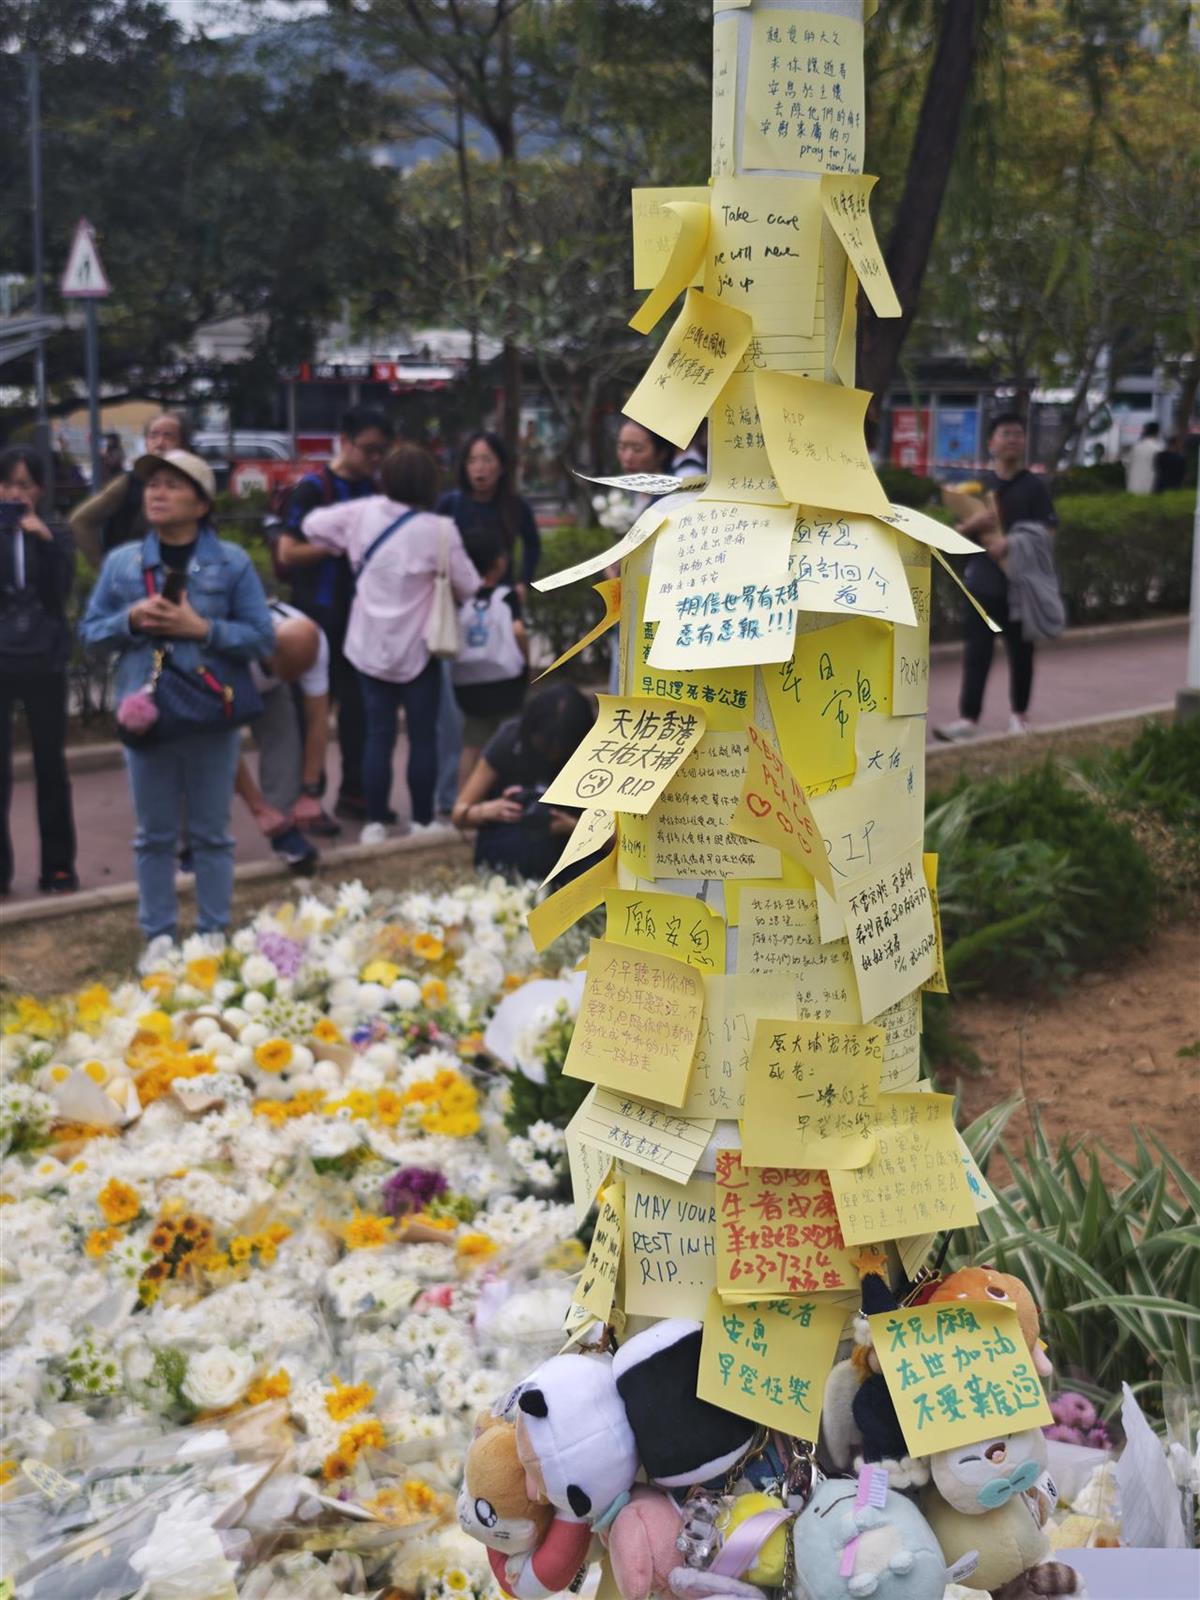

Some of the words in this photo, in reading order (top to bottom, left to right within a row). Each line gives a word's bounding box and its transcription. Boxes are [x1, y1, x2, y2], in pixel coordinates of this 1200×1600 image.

[722, 205, 759, 227] Take
[767, 213, 800, 231] care
[609, 709, 698, 746] 天佑香港
[588, 740, 684, 771] 天佑大埔
[625, 900, 715, 967] 願安息
[634, 1192, 671, 1221] MAY
[678, 1202, 716, 1224] YOUR
[632, 1231, 672, 1254] REST
[722, 1314, 767, 1357] 安息
[887, 1307, 981, 1352] 祝願
[896, 1325, 1017, 1390] 在世加油
[913, 1364, 1041, 1430] 不要難過
